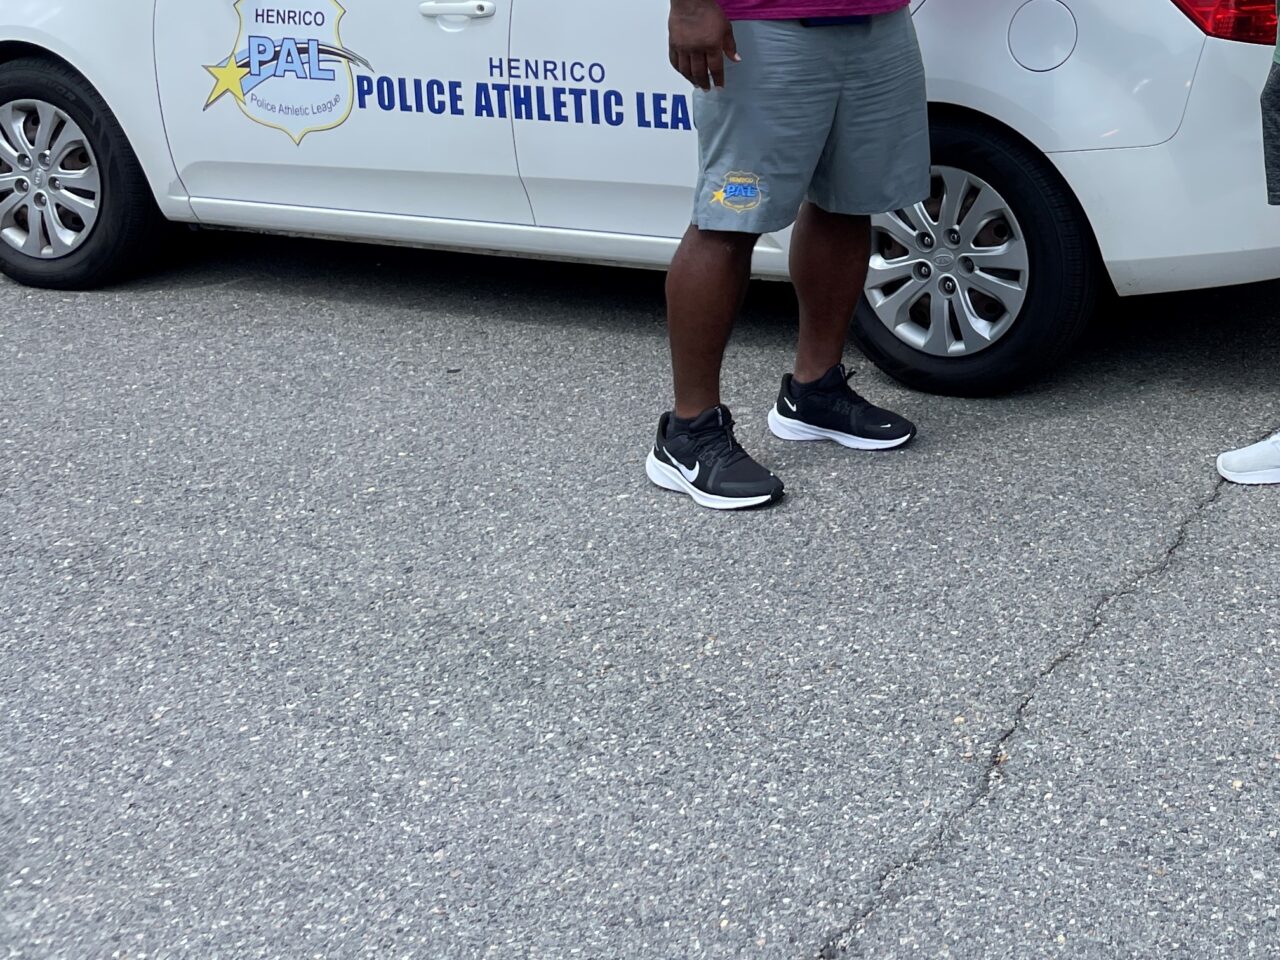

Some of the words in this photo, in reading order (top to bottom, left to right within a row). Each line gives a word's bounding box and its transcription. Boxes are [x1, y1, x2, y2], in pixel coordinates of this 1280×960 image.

[255, 8, 325, 26] HENRICO
[248, 35, 335, 81] PAL
[488, 57, 606, 84] HENRICO
[250, 93, 277, 113] Police
[278, 103, 310, 117] Athletic
[311, 93, 341, 117] League
[356, 75, 465, 116] POLICE
[474, 82, 624, 127] ATHLETIC
[636, 92, 693, 131] LEA
